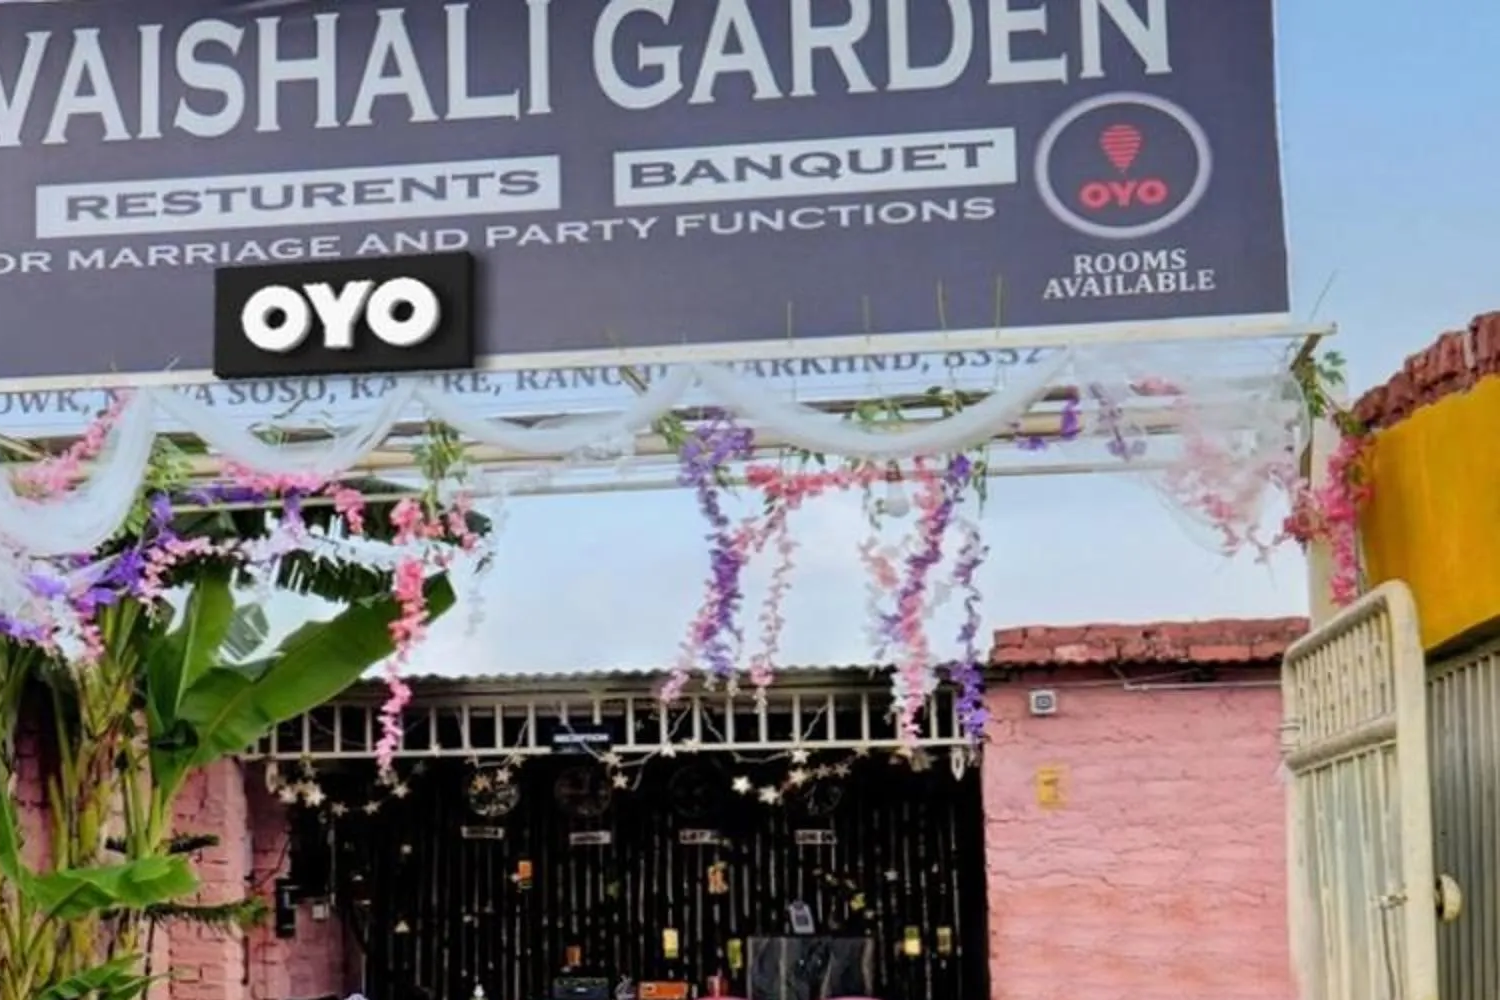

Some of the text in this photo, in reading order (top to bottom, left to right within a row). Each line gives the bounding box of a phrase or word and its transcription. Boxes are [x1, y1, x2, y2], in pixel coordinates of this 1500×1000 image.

[592, 0, 1172, 109] GARDEN
[629, 140, 995, 189] BANQUET
[65, 169, 541, 222] RESTURENTS
[1079, 178, 1169, 209] OYO
[67, 236, 342, 272] MARRIAGE
[355, 228, 467, 255] AND
[485, 216, 660, 250] PARTY
[675, 197, 997, 237] FUNCTIONS
[1042, 268, 1216, 300] AVAILABLE
[1072, 248, 1188, 275] ROOMS
[241, 276, 441, 353] OYO
